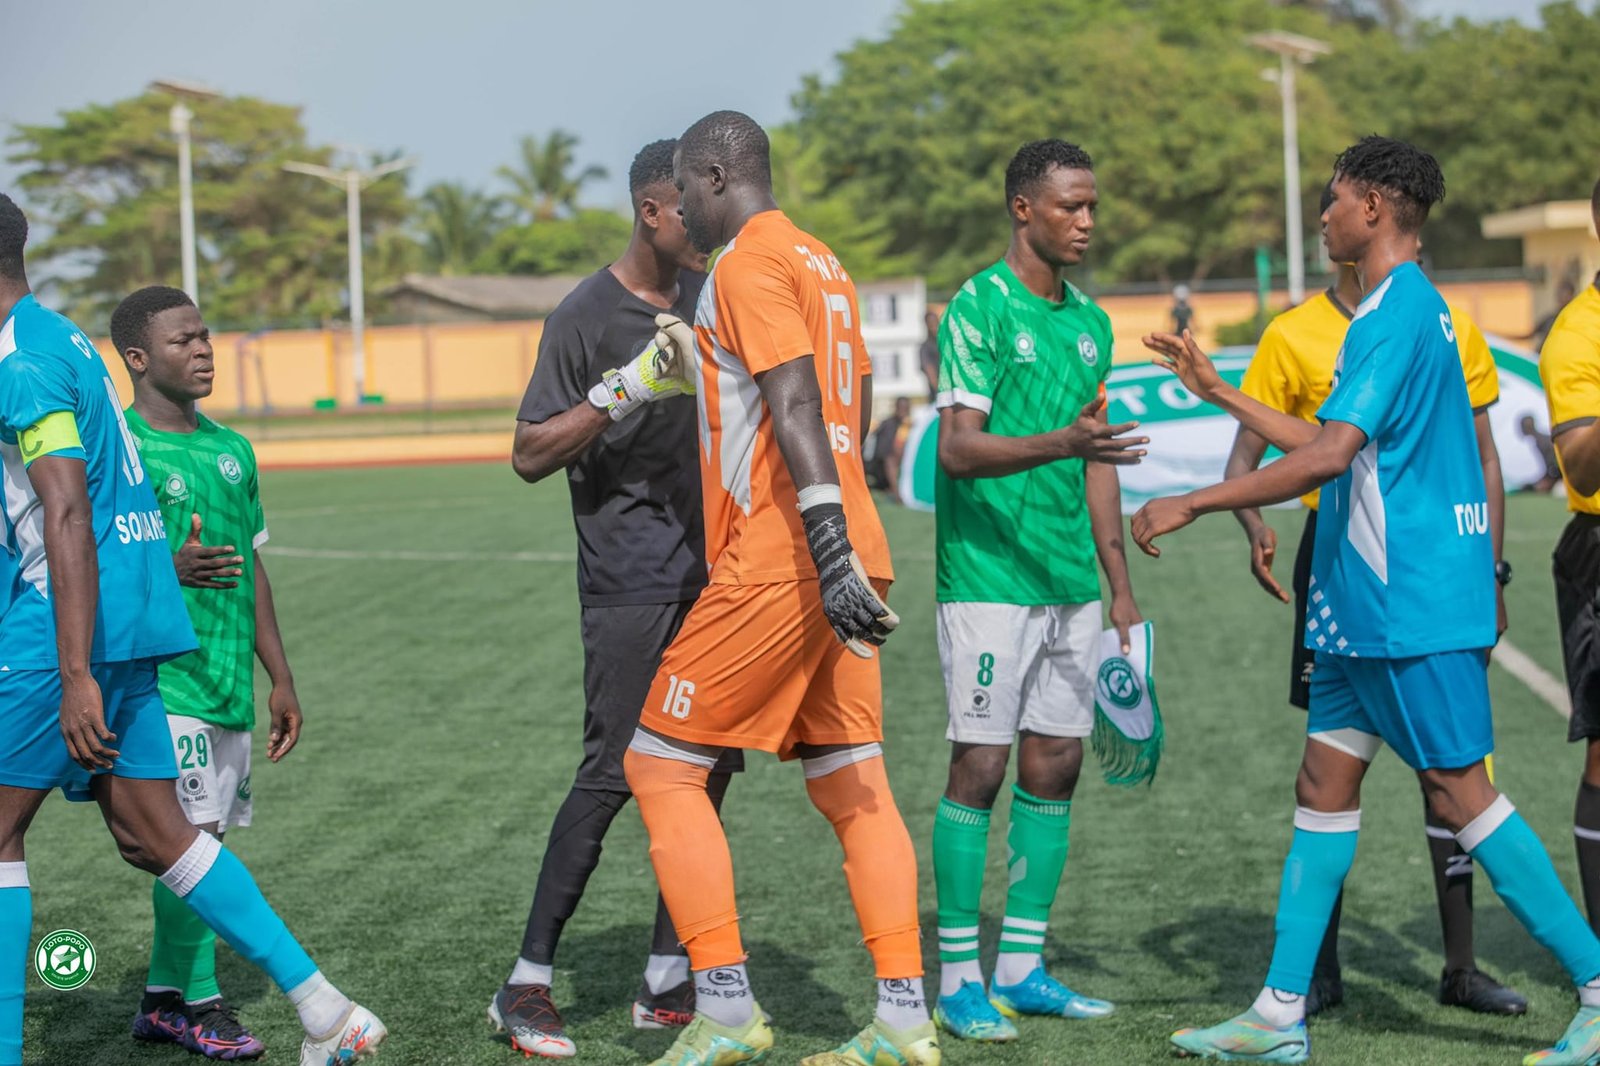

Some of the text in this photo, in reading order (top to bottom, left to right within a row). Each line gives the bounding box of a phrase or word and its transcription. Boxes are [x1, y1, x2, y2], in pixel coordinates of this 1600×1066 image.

[821, 287, 853, 407] 16
[825, 422, 850, 454] IS
[977, 652, 995, 687] 8
[662, 674, 696, 719] 16
[177, 733, 208, 770] 29
